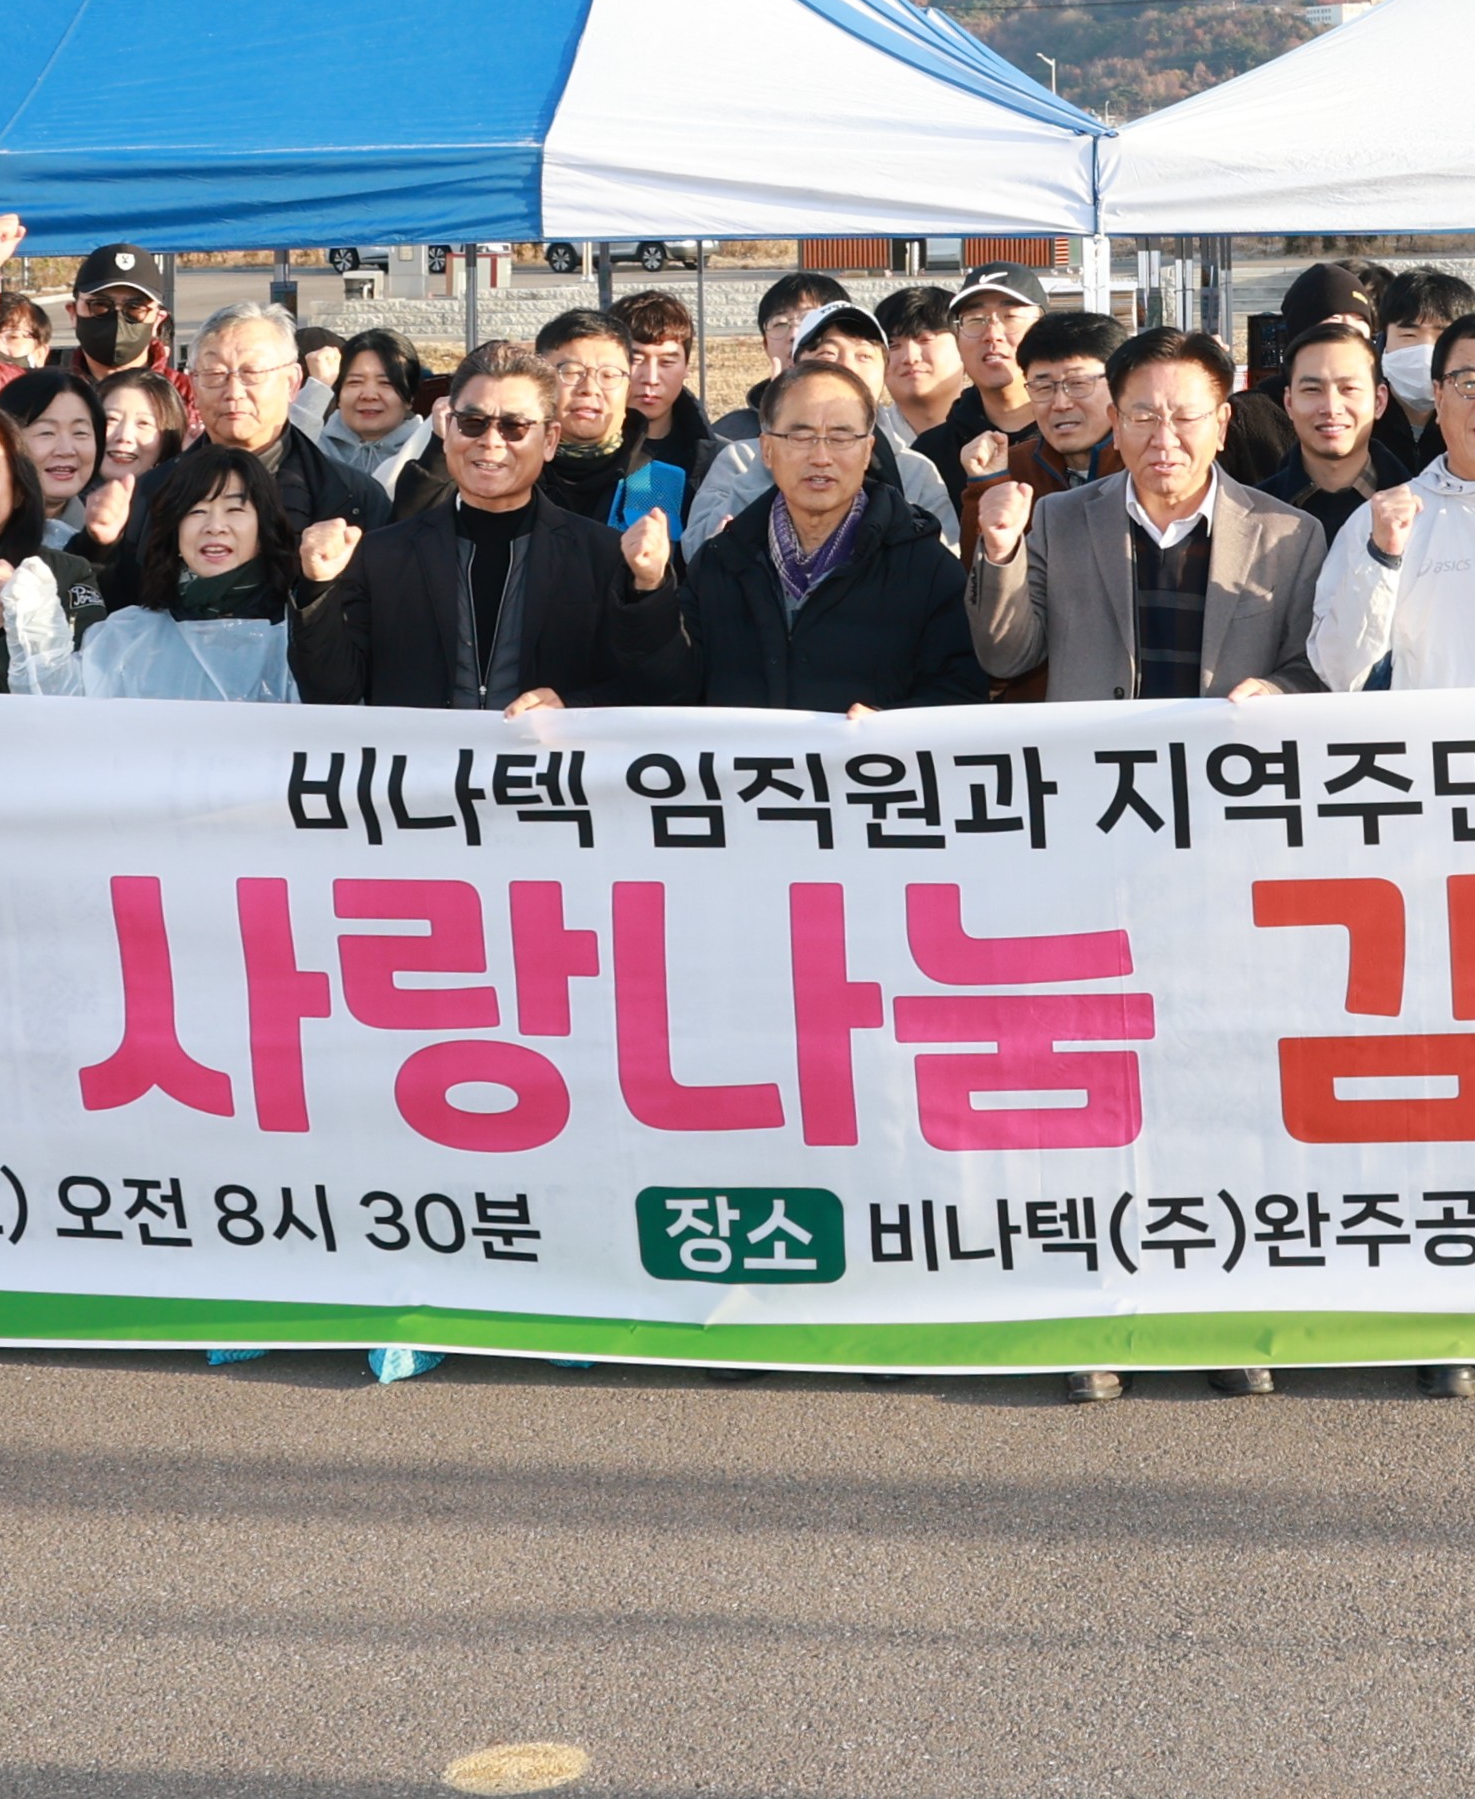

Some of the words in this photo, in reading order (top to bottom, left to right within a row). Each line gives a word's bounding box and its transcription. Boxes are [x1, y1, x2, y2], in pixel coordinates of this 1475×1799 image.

[288, 748, 593, 847] 비나텍
[626, 747, 1057, 849] 임직원과
[80, 877, 1154, 1152] 사랑나눔
[57, 1176, 192, 1248] 오전
[215, 1185, 336, 1251] 8시
[360, 1191, 540, 1262] 30분
[666, 1197, 816, 1272] 장소
